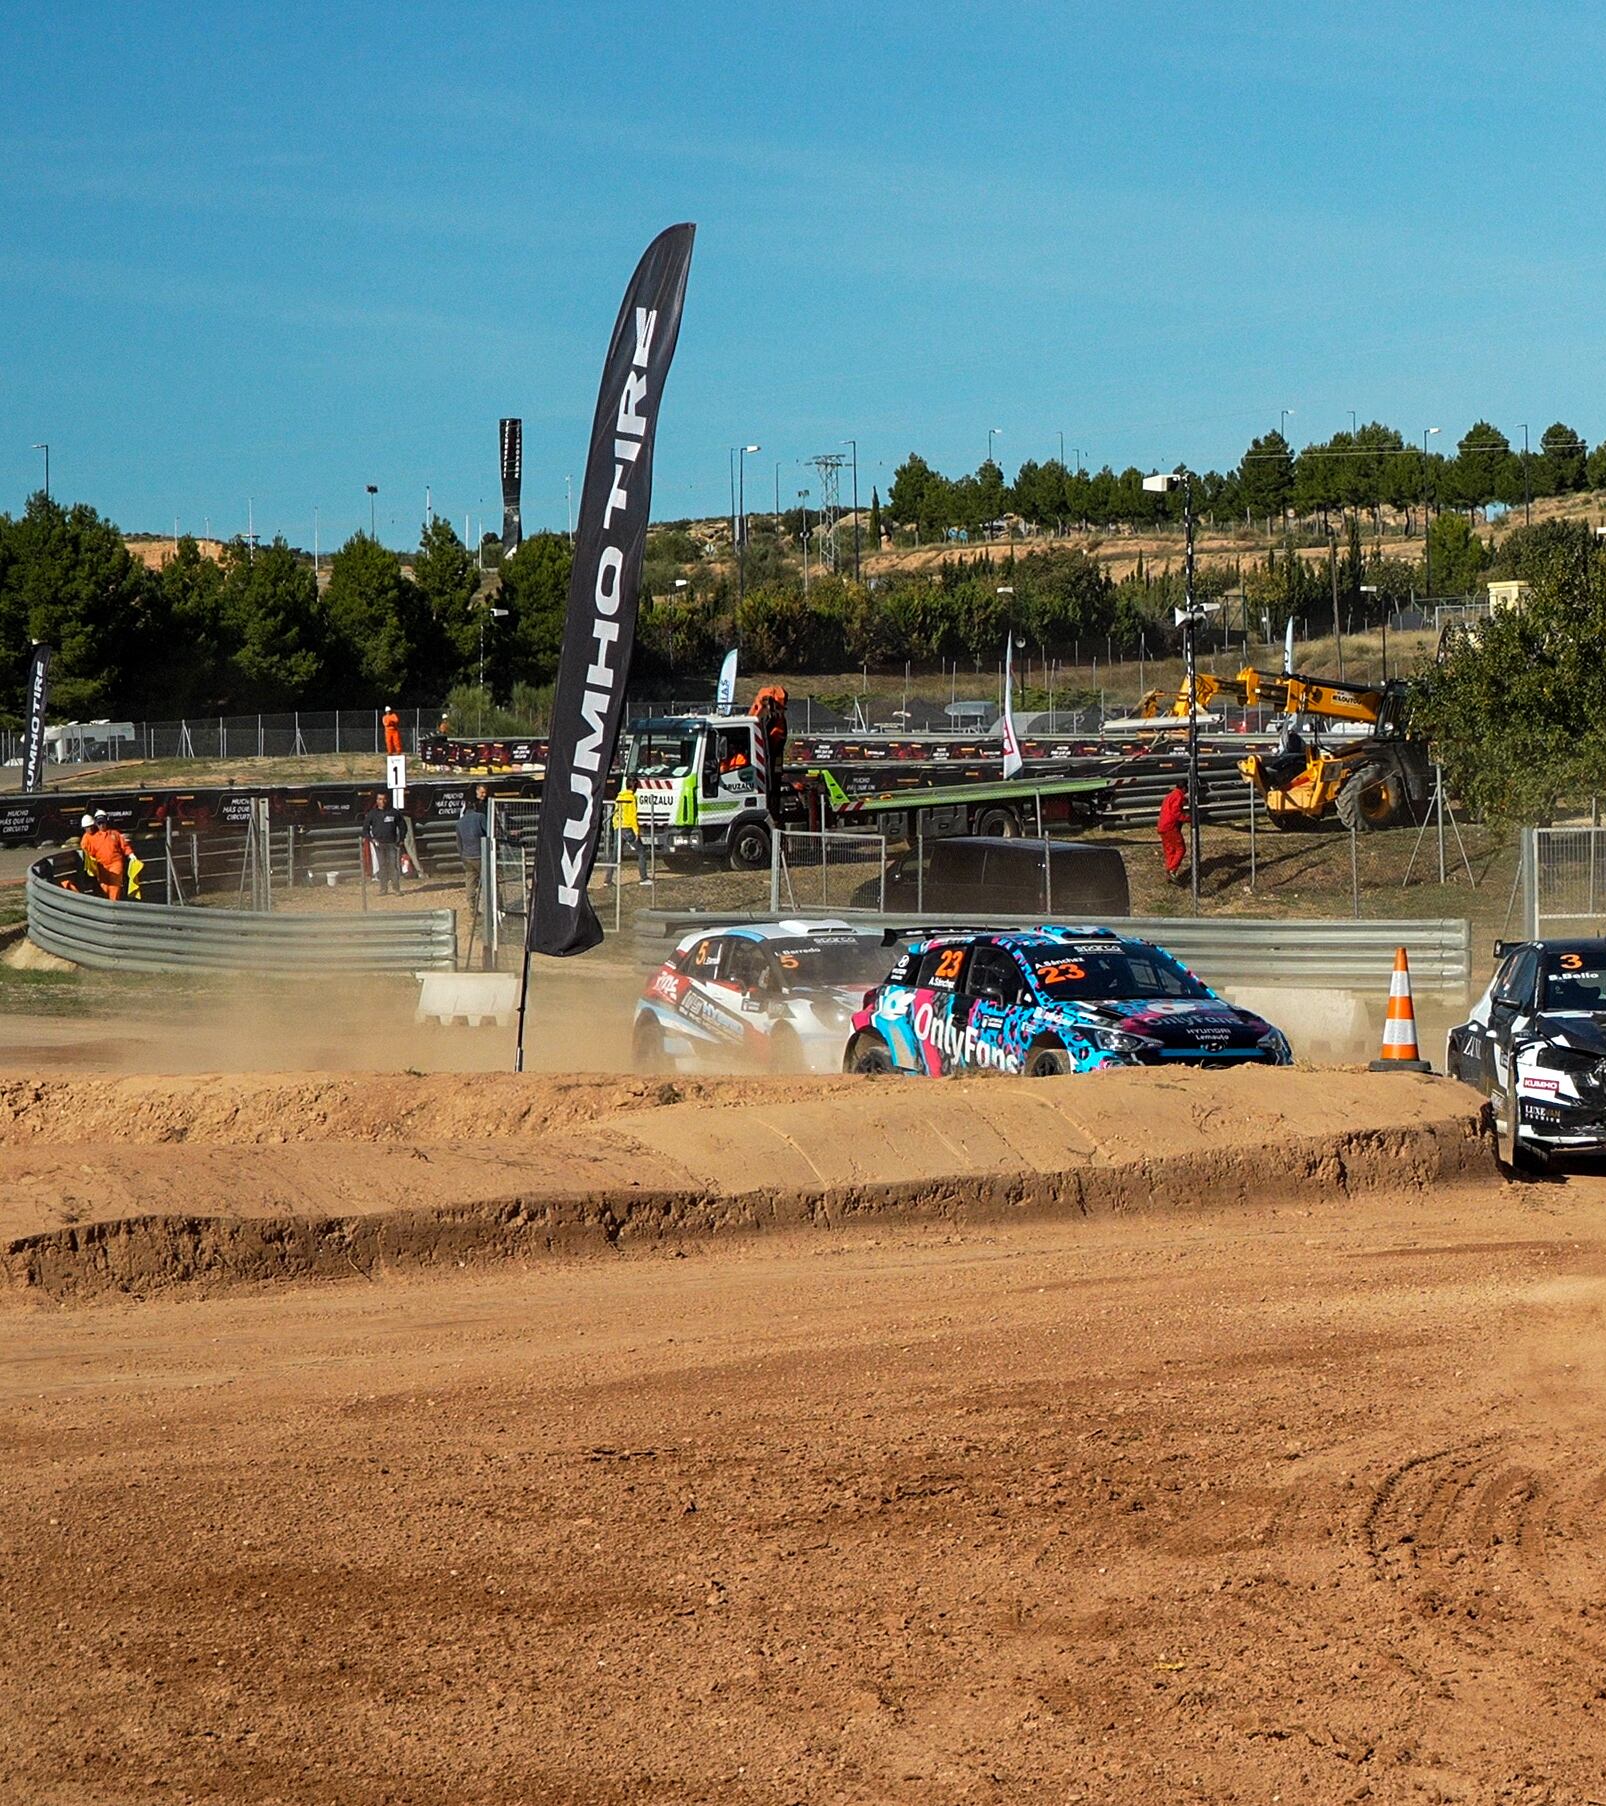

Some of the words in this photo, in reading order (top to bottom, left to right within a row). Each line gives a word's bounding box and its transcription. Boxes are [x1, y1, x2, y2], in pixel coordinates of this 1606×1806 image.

[558, 545, 623, 908] KUMHO
[603, 306, 657, 531] TIRE
[32, 660, 45, 714] TIRE
[392, 766, 398, 785] 1
[442, 792, 464, 800] MUCHO
[639, 794, 674, 806] GRUZALU
[7, 809, 29, 817] MUCHO
[226, 813, 250, 821] CIRCUIT
[13, 817, 24, 825] QUE
[3, 825, 29, 833] CIRCUITO
[696, 941, 709, 965] 5
[1073, 944, 1123, 953] sparco
[780, 955, 799, 969] 5
[935, 950, 964, 977] 23
[1559, 953, 1584, 969] 3
[1037, 963, 1086, 984] 23
[914, 1003, 1019, 1074] OnlyFans
[1524, 1079, 1557, 1089] KUMHO
